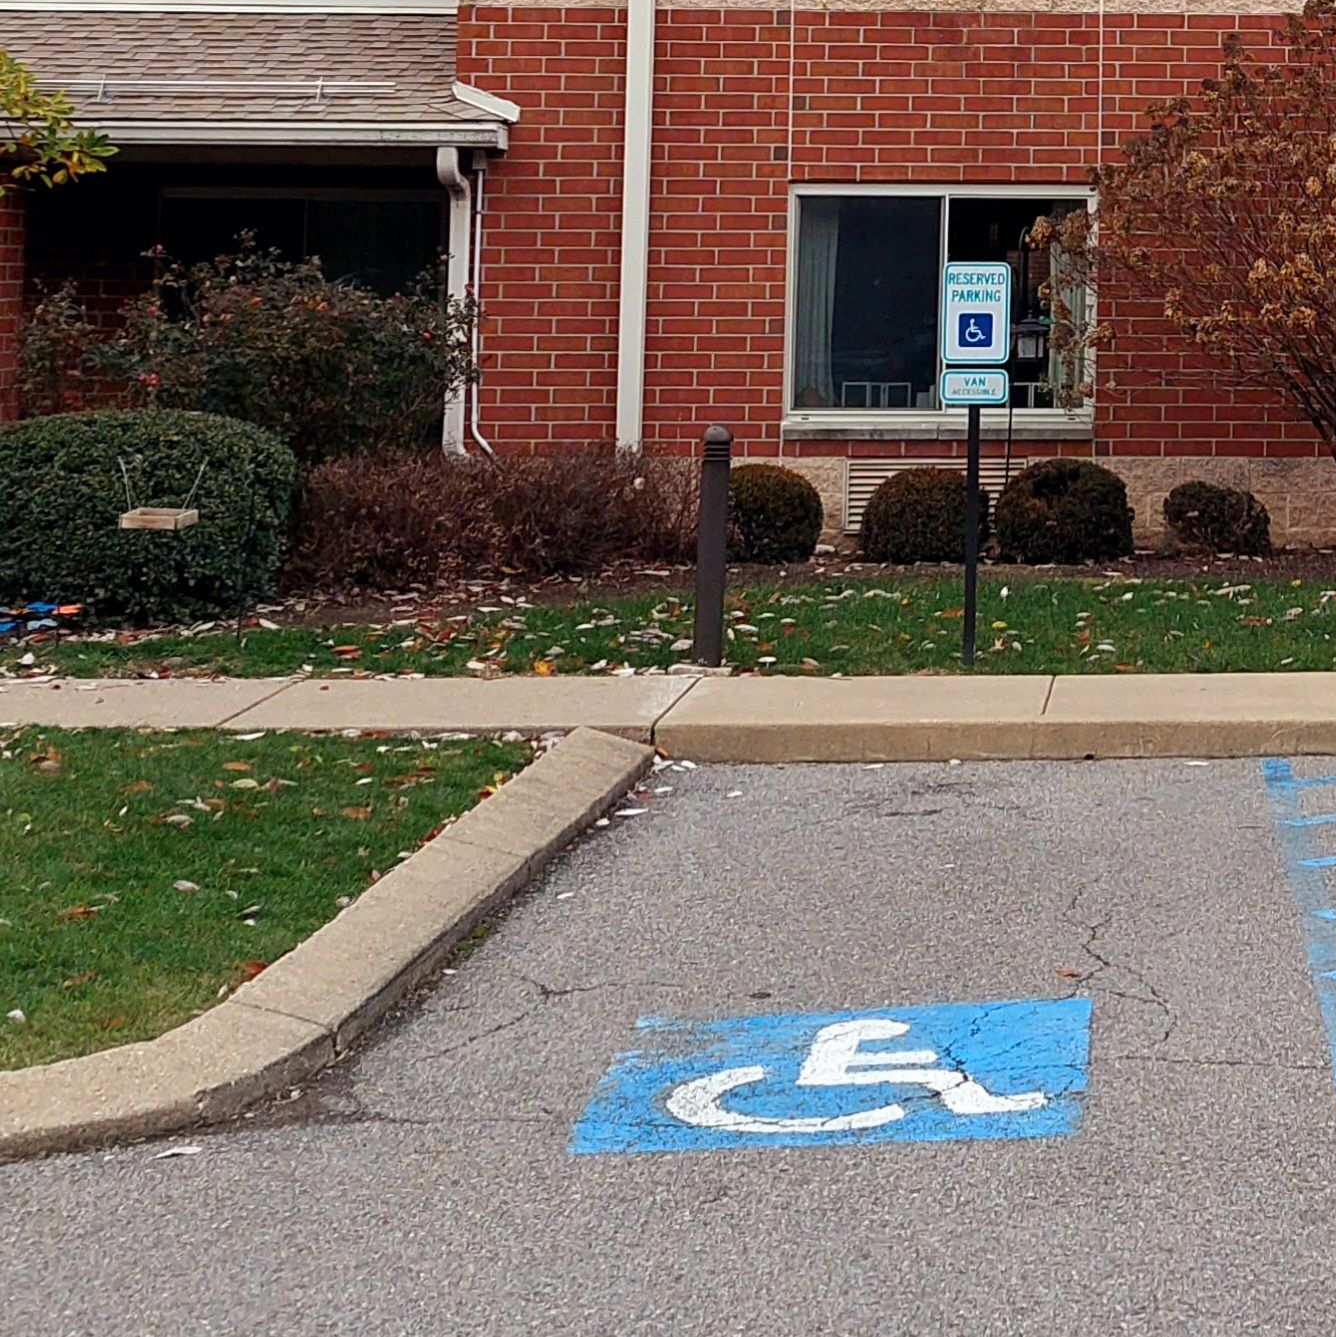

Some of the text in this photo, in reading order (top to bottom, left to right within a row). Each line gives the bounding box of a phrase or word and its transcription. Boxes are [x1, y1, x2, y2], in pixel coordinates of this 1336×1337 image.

[948, 272, 1005, 285] RESERVED
[952, 289, 1001, 302] PARKING
[964, 377, 986, 386] VAN
[952, 387, 997, 395] ACCESSIBLE
